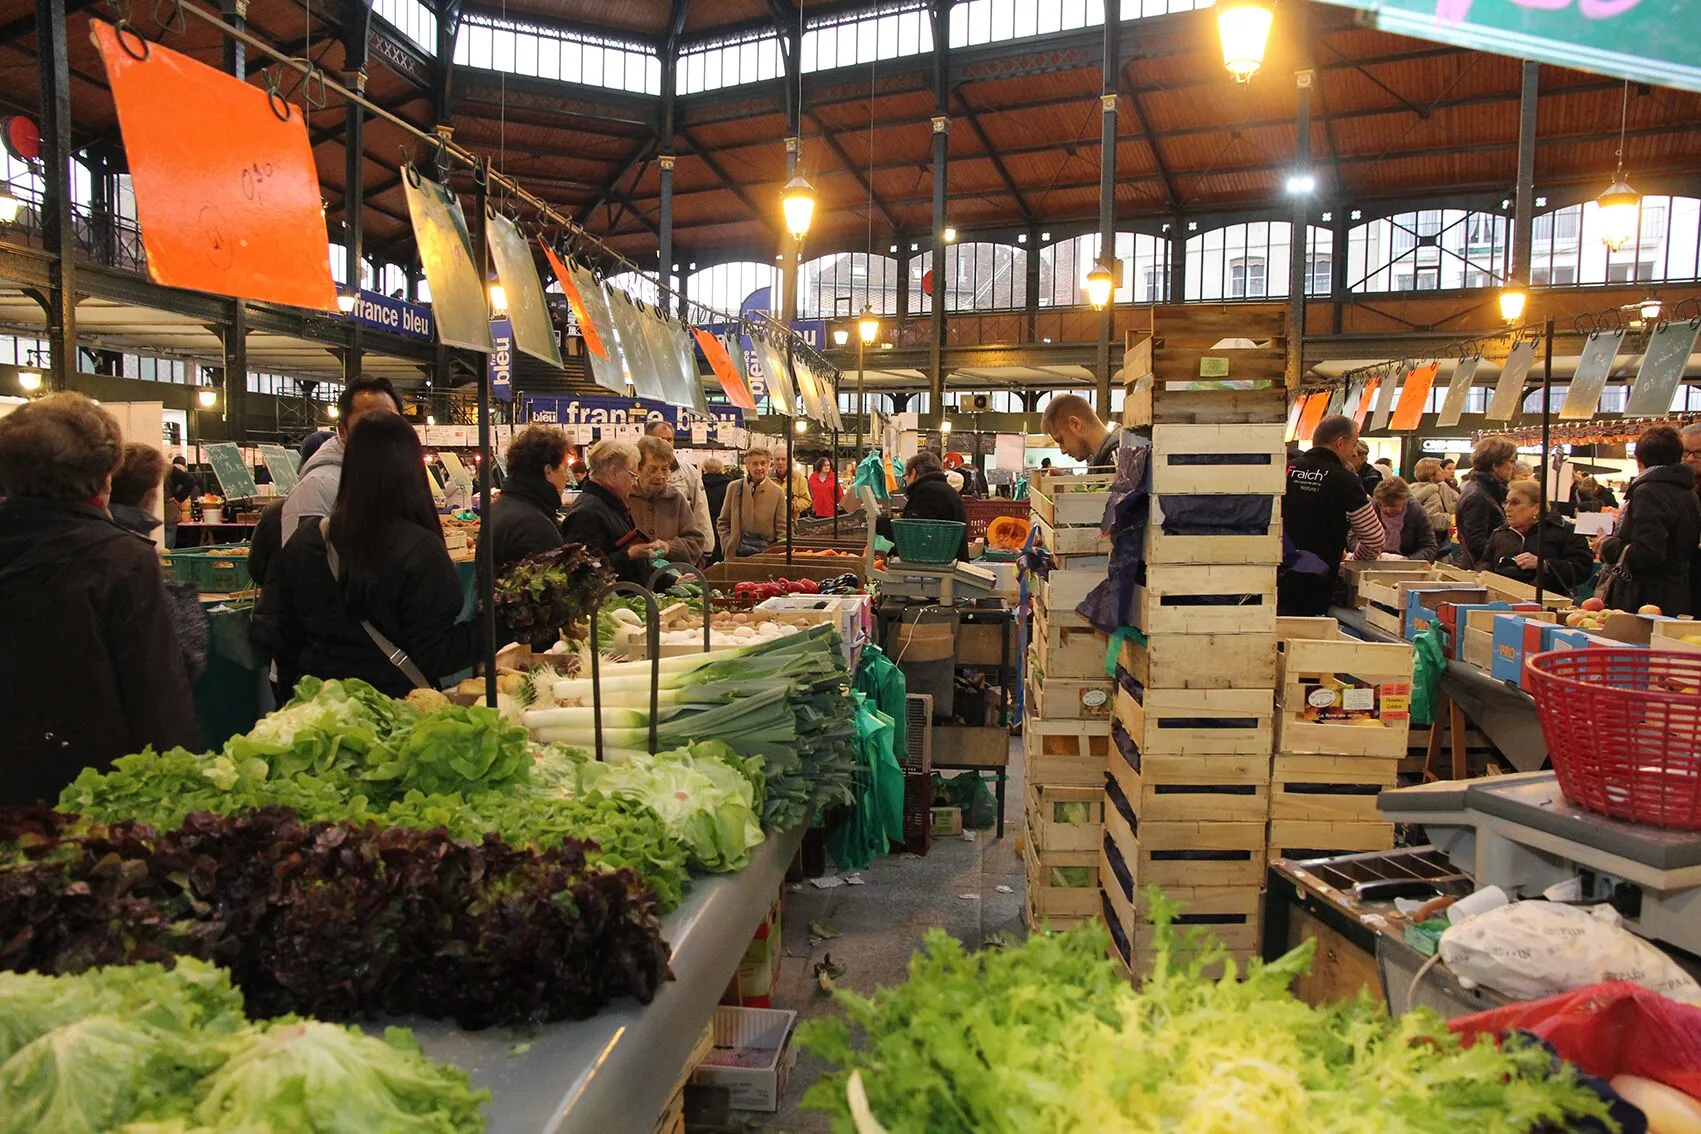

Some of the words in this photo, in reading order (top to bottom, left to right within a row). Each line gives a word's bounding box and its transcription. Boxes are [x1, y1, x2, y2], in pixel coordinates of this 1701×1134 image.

[354, 292, 399, 327] france
[402, 307, 429, 336] bleu
[493, 337, 511, 386] bleu
[532, 411, 556, 423] bleu
[566, 400, 665, 428] frane
